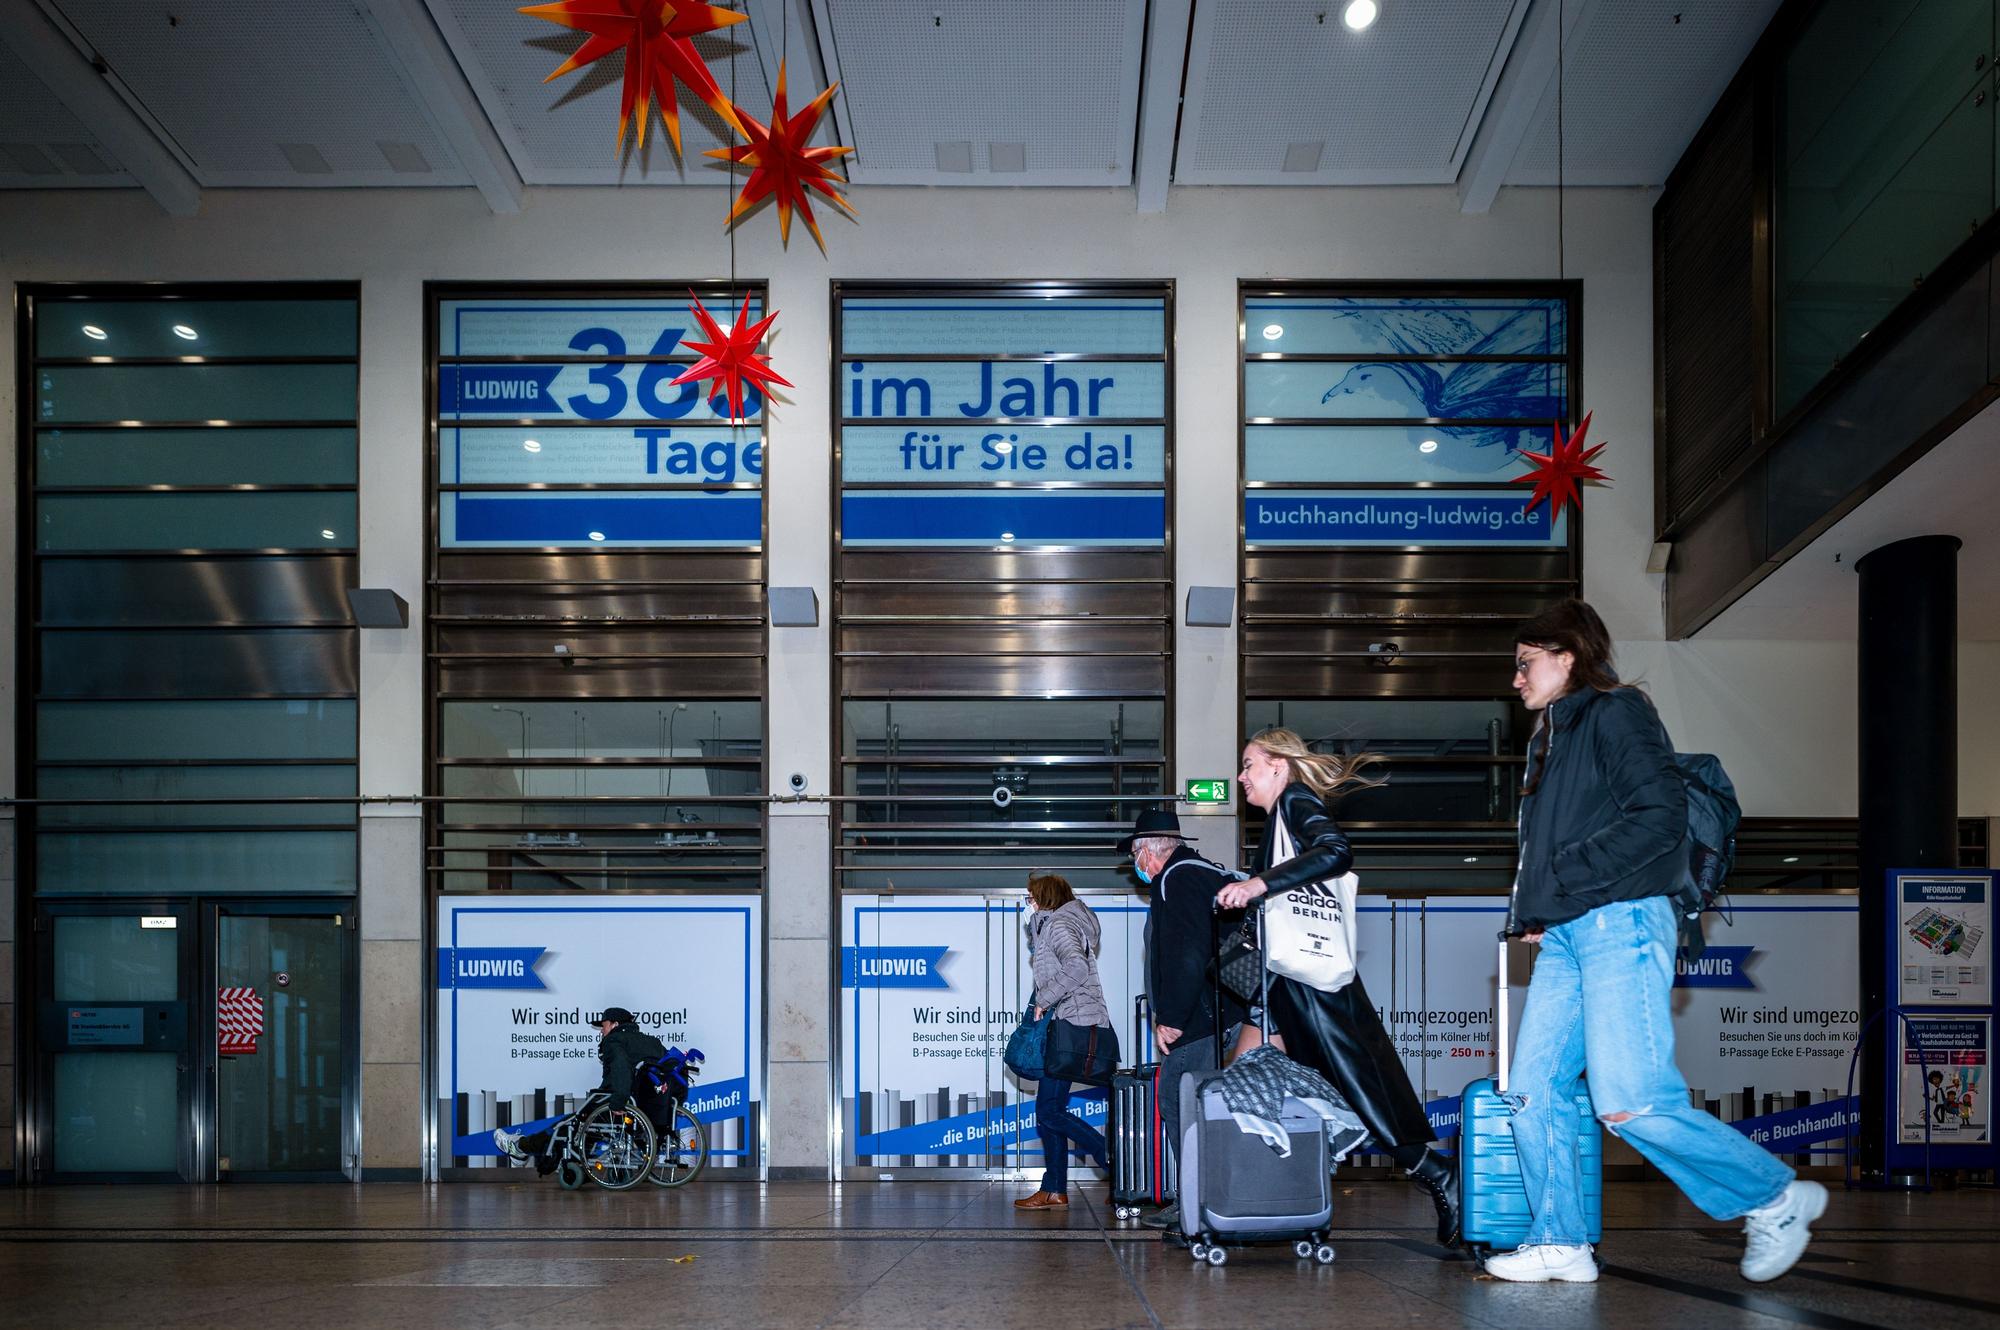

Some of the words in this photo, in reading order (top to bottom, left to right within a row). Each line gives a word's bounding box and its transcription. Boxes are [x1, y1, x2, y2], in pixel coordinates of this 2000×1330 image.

[464, 380, 539, 400] LUDWIG
[851, 361, 932, 417] im
[959, 351, 1114, 418] Jahr
[900, 432, 964, 470] für
[980, 434, 1047, 470] Sie
[1065, 432, 1133, 470] da!
[634, 428, 762, 494] Tage
[1258, 505, 1540, 530] buchhandlung-ludwig.de
[1922, 885, 1966, 894] INFORMATION
[1287, 893, 1343, 912] adidas
[1292, 906, 1342, 923] BERLIN
[458, 959, 524, 977] LUDWIG
[861, 959, 927, 976] LUDWIG
[1676, 958, 1733, 976] UDWIG
[511, 1008, 542, 1025] Wir
[545, 1008, 580, 1025] sind
[913, 1007, 941, 1024] Wir
[946, 1006, 981, 1024] sind
[1390, 1008, 1493, 1028] umgezogen!
[1720, 1006, 1748, 1023] Wir
[1753, 1006, 1787, 1024] sind
[1793, 1010, 1859, 1028] umgezo
[511, 1033, 557, 1043] Besuchen
[559, 1033, 574, 1043] Sie
[576, 1034, 593, 1043] uns
[667, 1032, 687, 1043] Hbf.
[912, 1032, 958, 1042] Besuchen
[960, 1032, 976, 1042] Sie
[1400, 1032, 1424, 1042] doch
[1426, 1032, 1438, 1042] im
[1440, 1032, 1470, 1042] Kölner
[1473, 1032, 1492, 1042] Hbf.
[1719, 1031, 1765, 1042] Besuchen
[1767, 1032, 1782, 1042] Sie
[1784, 1033, 1801, 1042] uns
[1804, 1031, 1825, 1042] doch
[1828, 1032, 1840, 1042] im
[511, 1049, 561, 1060] B-Passage
[564, 1049, 586, 1058] Ecke
[912, 1048, 962, 1059] B-Passage
[964, 1048, 987, 1058] Ecke
[1451, 1048, 1471, 1057] 250
[1719, 1047, 1769, 1059] B-Passage
[1771, 1047, 1793, 1057] Ecke
[1796, 1047, 1844, 1059] E-Passage
[929, 1128, 963, 1149] ...die
